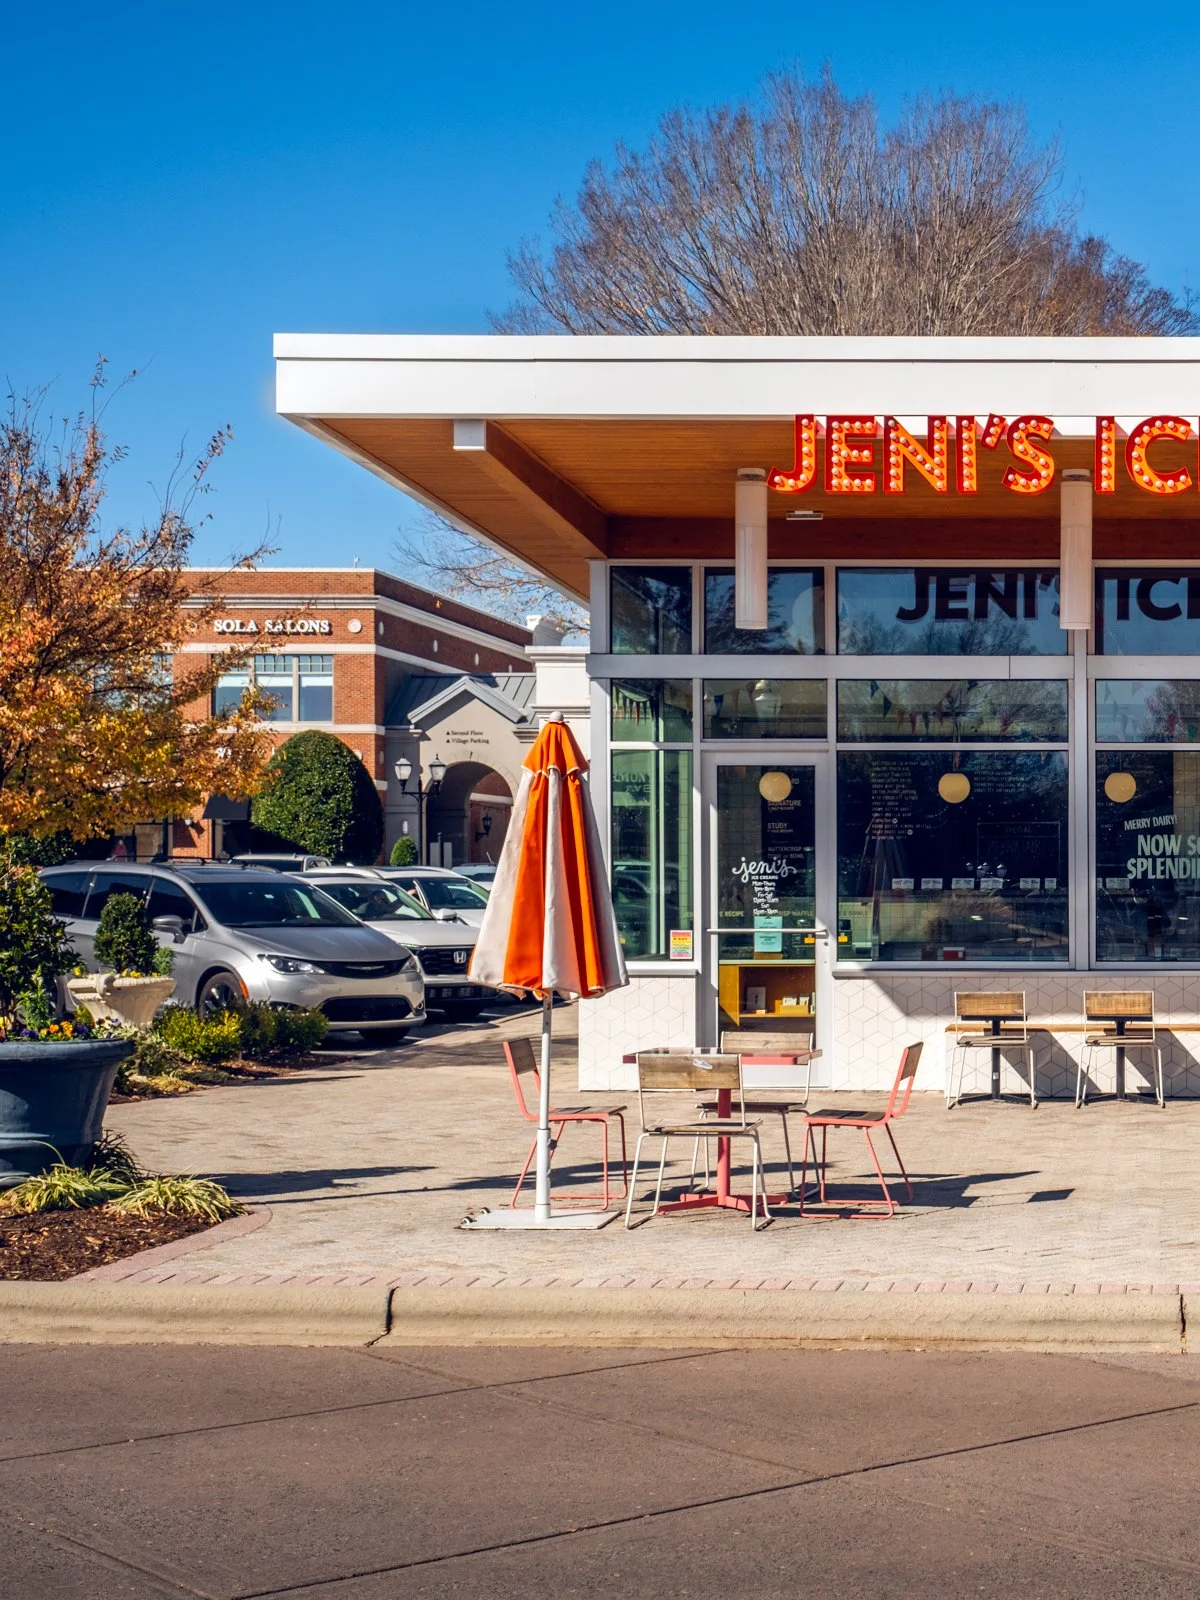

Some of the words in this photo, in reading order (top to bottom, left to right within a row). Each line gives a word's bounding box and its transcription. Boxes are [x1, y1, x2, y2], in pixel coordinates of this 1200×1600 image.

[766, 413, 1055, 495] JENI'S
[896, 573, 1060, 621] JENI'
[214, 619, 259, 633] SOLA
[265, 619, 331, 633] SALONS
[1123, 817, 1151, 831] MERRY
[1152, 814, 1178, 827] DAIRY!
[1137, 834, 1183, 856] NOW
